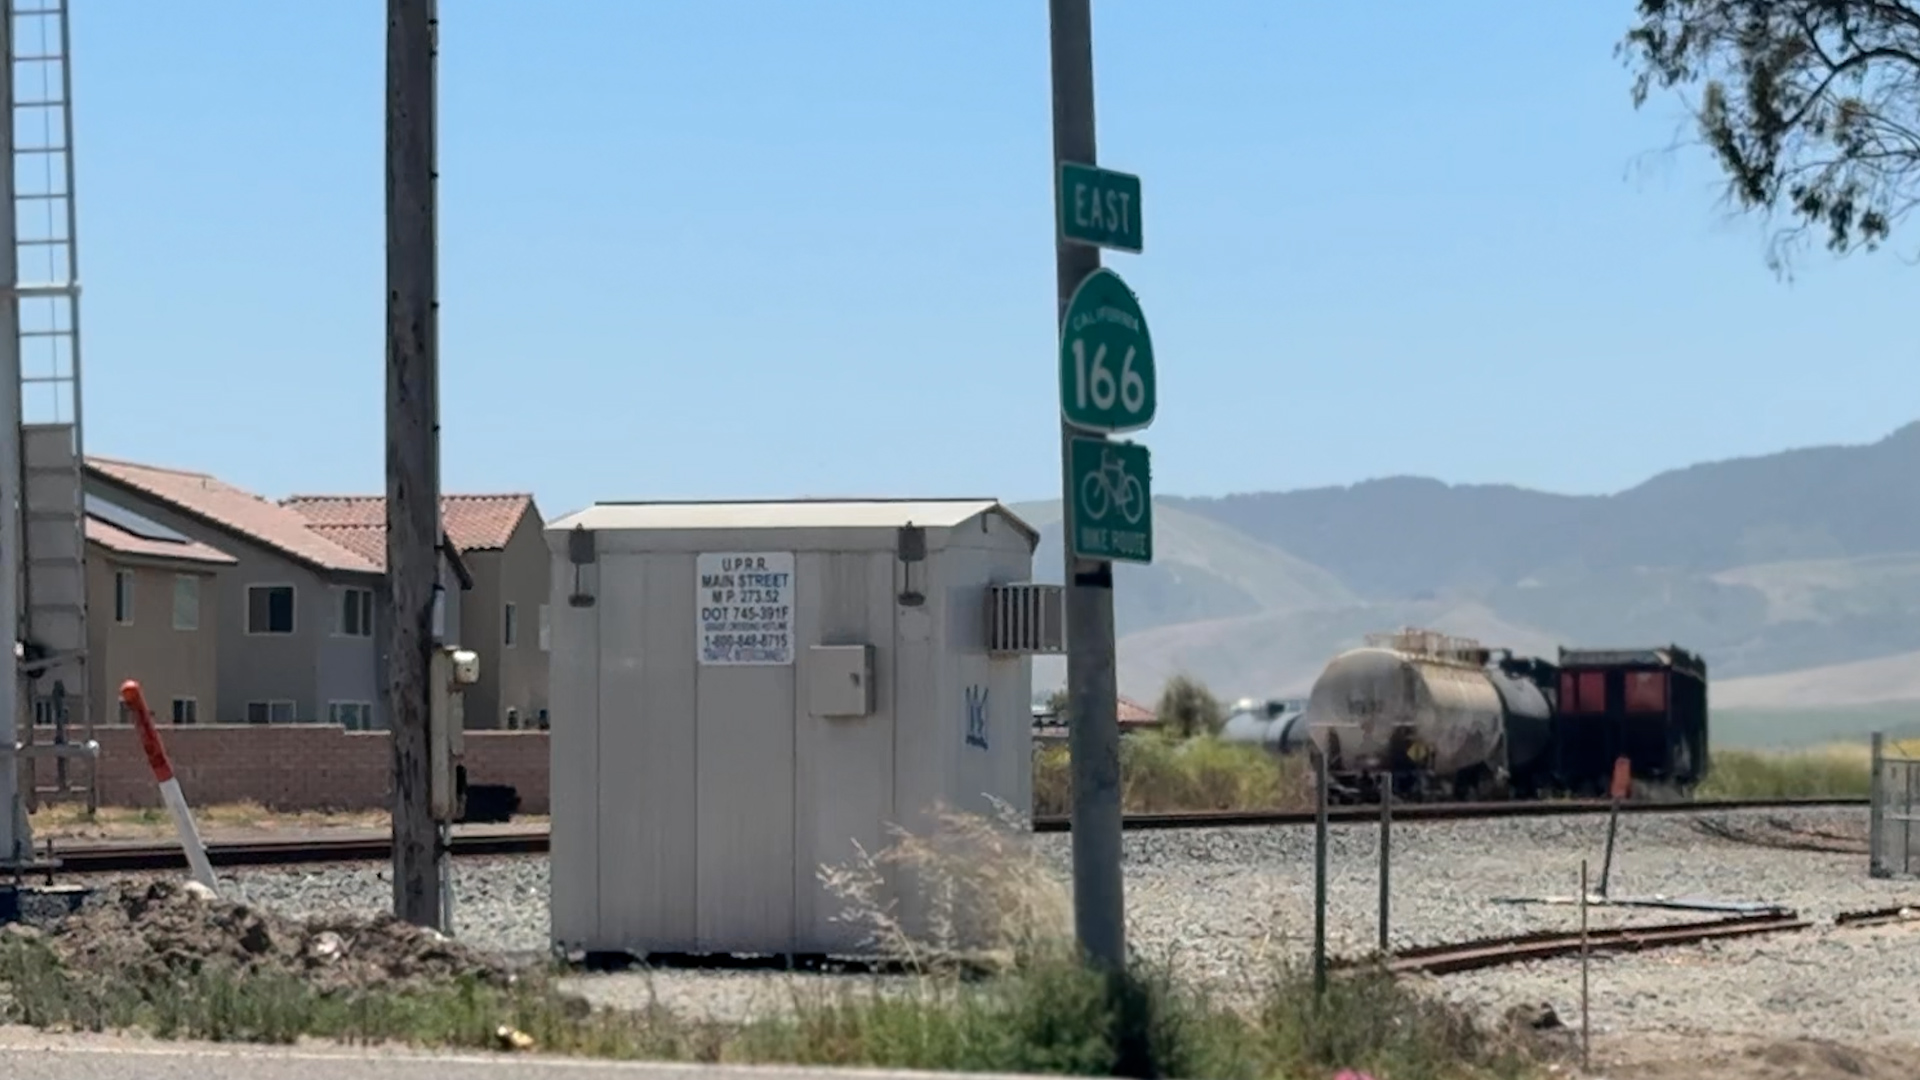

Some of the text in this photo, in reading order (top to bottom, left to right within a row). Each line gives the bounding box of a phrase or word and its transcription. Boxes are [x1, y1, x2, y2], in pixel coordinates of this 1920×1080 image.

[1075, 182, 1130, 235] EAST
[1072, 338, 1145, 414] 166
[702, 573, 788, 588] MAIN STREET
[702, 606, 788, 621] DOT 745-391F
